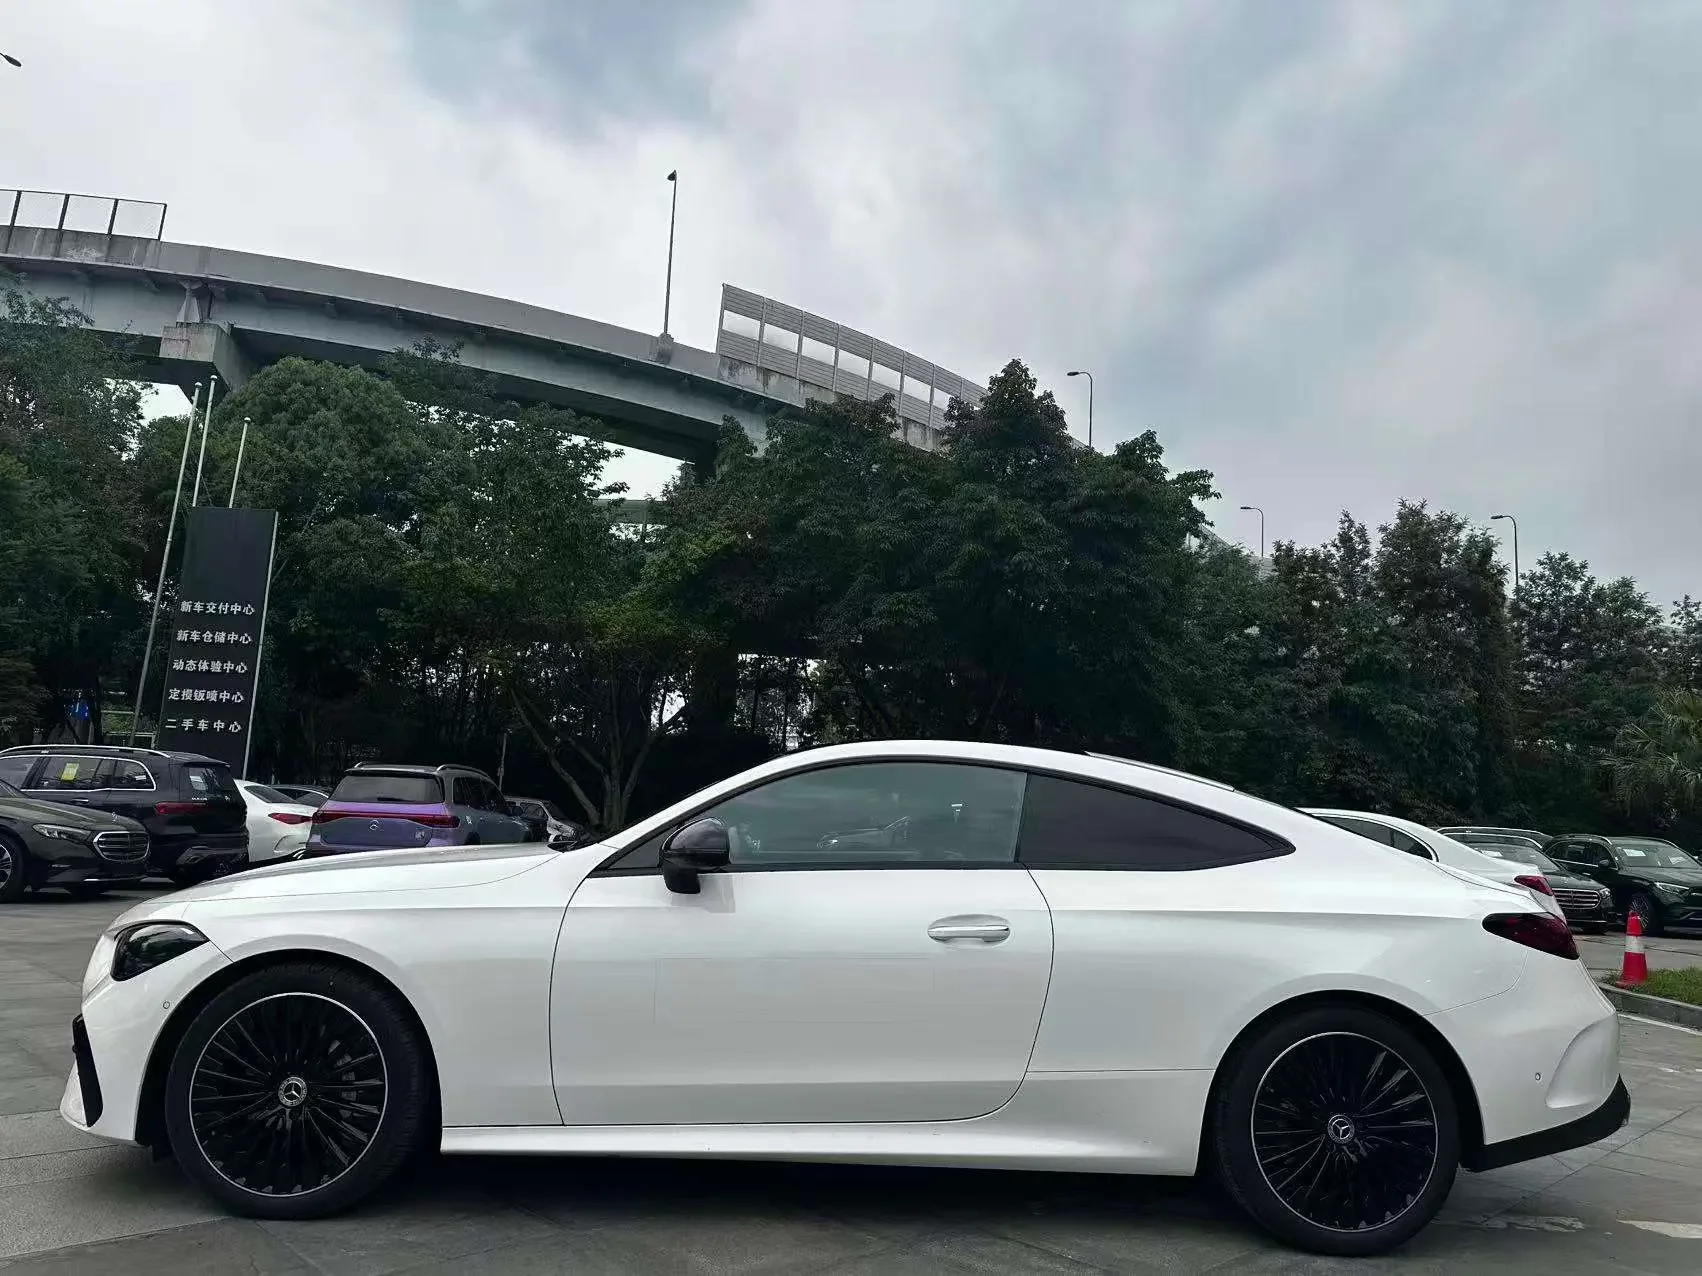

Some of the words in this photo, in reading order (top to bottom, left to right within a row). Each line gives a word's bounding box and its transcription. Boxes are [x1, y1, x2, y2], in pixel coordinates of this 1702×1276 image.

[180, 601, 256, 616] 新车交付中心
[176, 630, 252, 645] 新车仓储中心
[172, 659, 248, 674] 动态体验中心
[165, 718, 242, 734] 二手车中心
